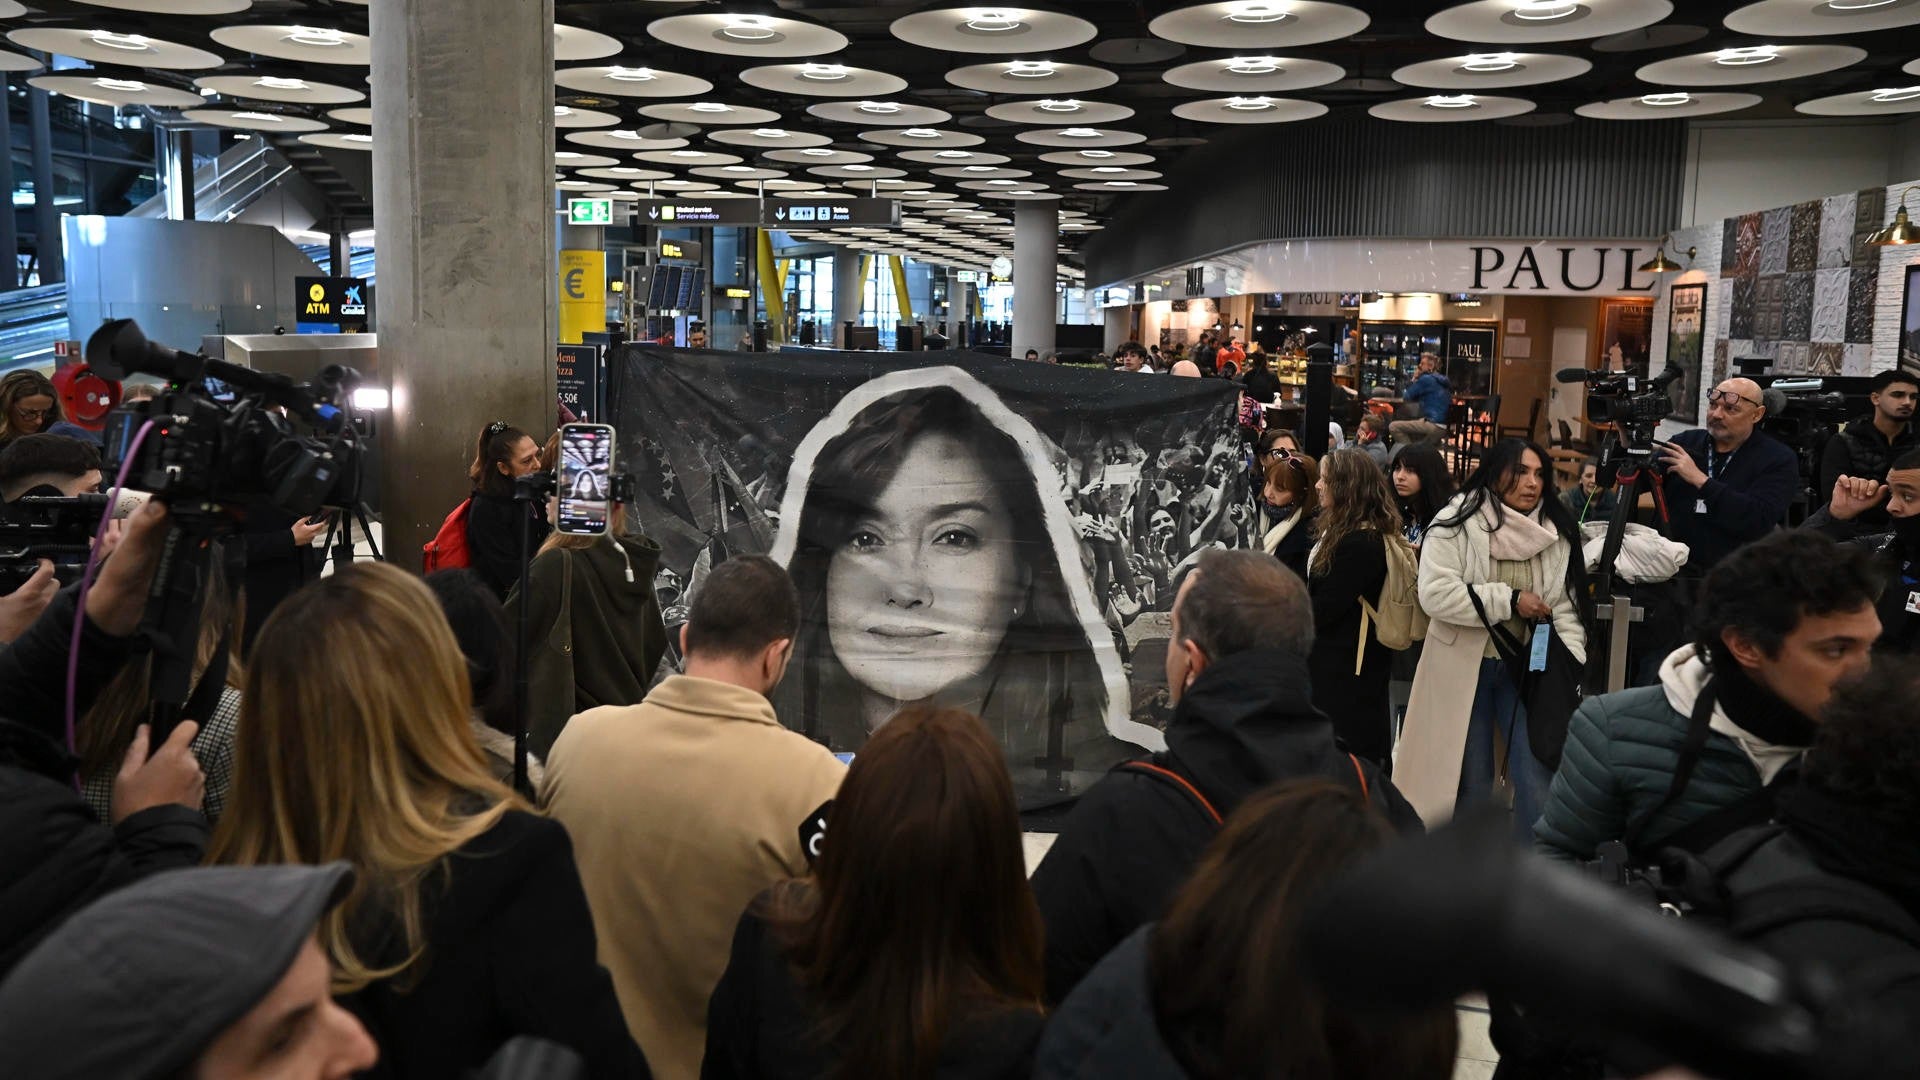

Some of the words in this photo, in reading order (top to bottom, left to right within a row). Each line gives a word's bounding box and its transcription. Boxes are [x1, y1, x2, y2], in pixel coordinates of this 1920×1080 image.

[1469, 246, 1656, 291] PAUL
[1298, 292, 1331, 304] PAUL
[306, 303, 329, 314] ATM
[1457, 343, 1482, 358] PAUL
